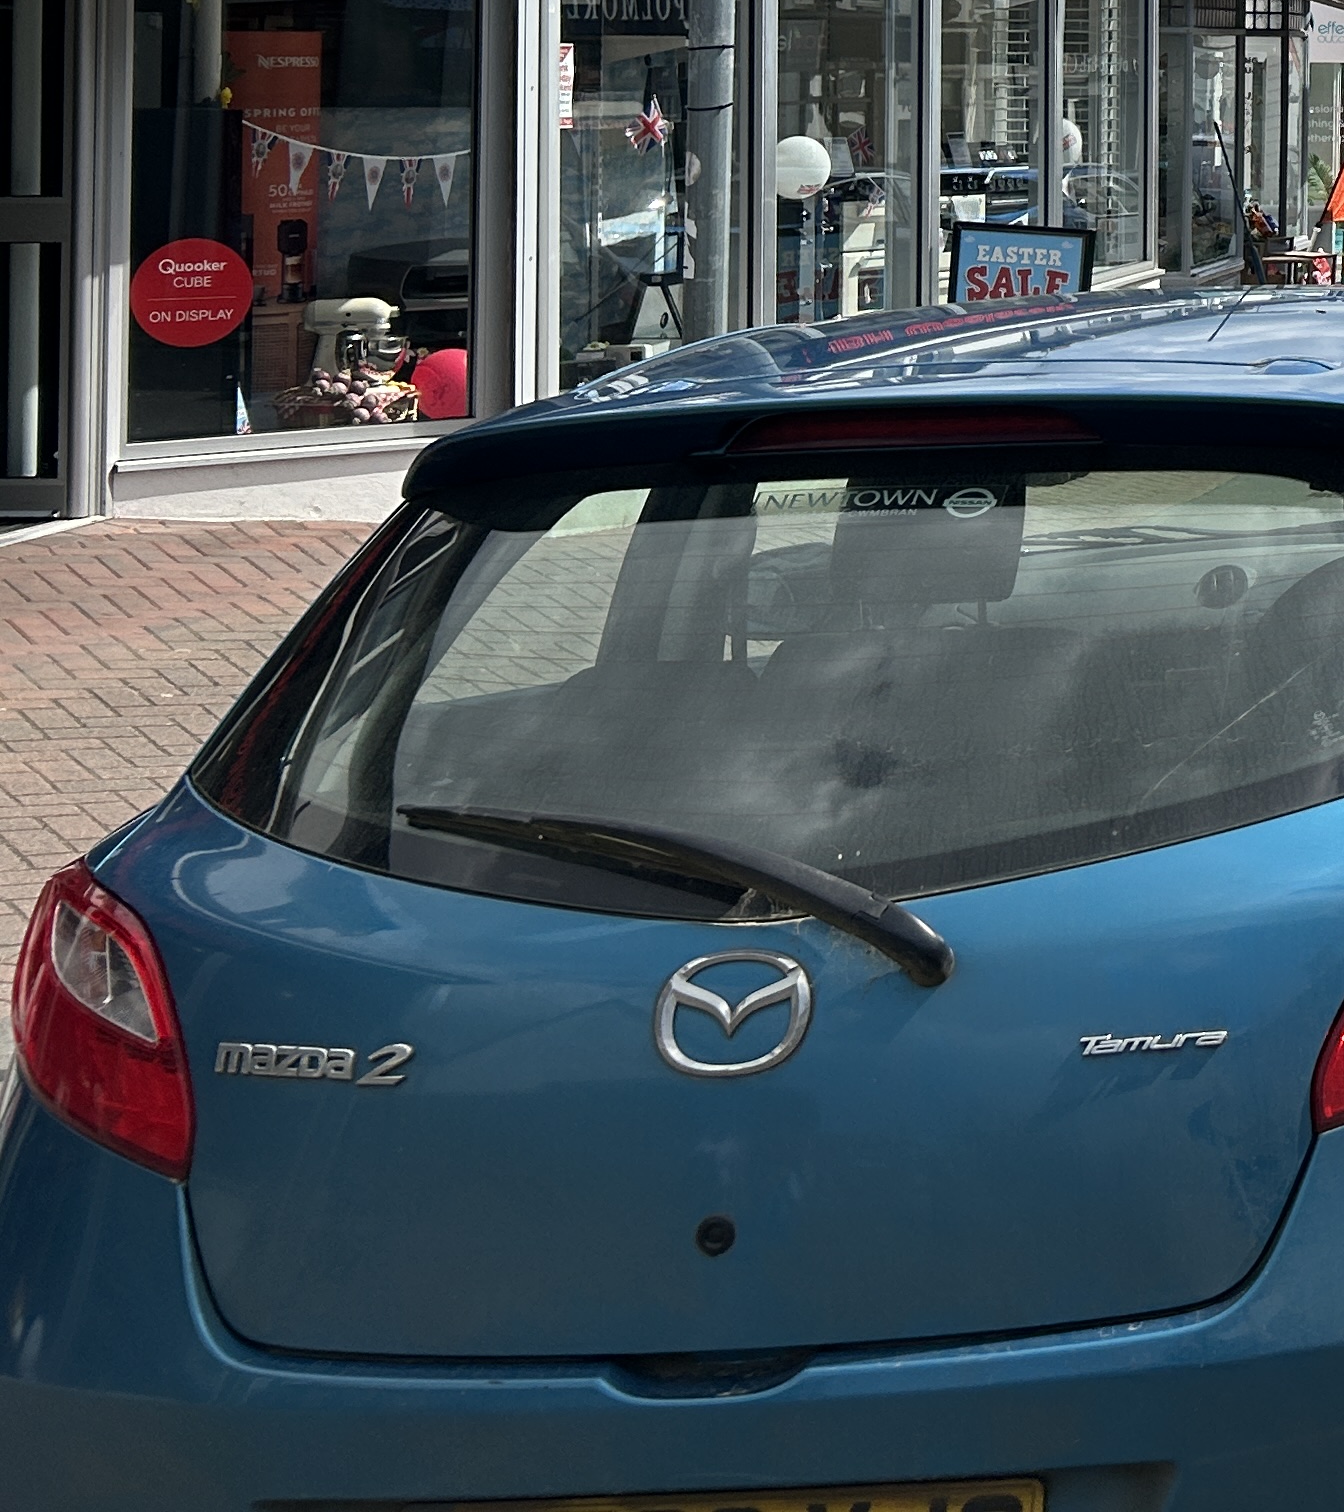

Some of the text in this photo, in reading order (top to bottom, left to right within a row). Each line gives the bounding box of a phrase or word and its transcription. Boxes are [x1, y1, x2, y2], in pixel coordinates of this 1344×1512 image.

[257, 54, 321, 69] NESPRESSO
[243, 107, 297, 118] SPRING
[976, 244, 1062, 267] EASTER
[158, 258, 228, 275] Quooker
[173, 275, 213, 288] CUBE
[965, 264, 1070, 302] SALE
[148, 308, 235, 323] ON DISPLAY
[764, 488, 939, 511] NEWTOWN
[1078, 1025, 1228, 1057] Tamura
